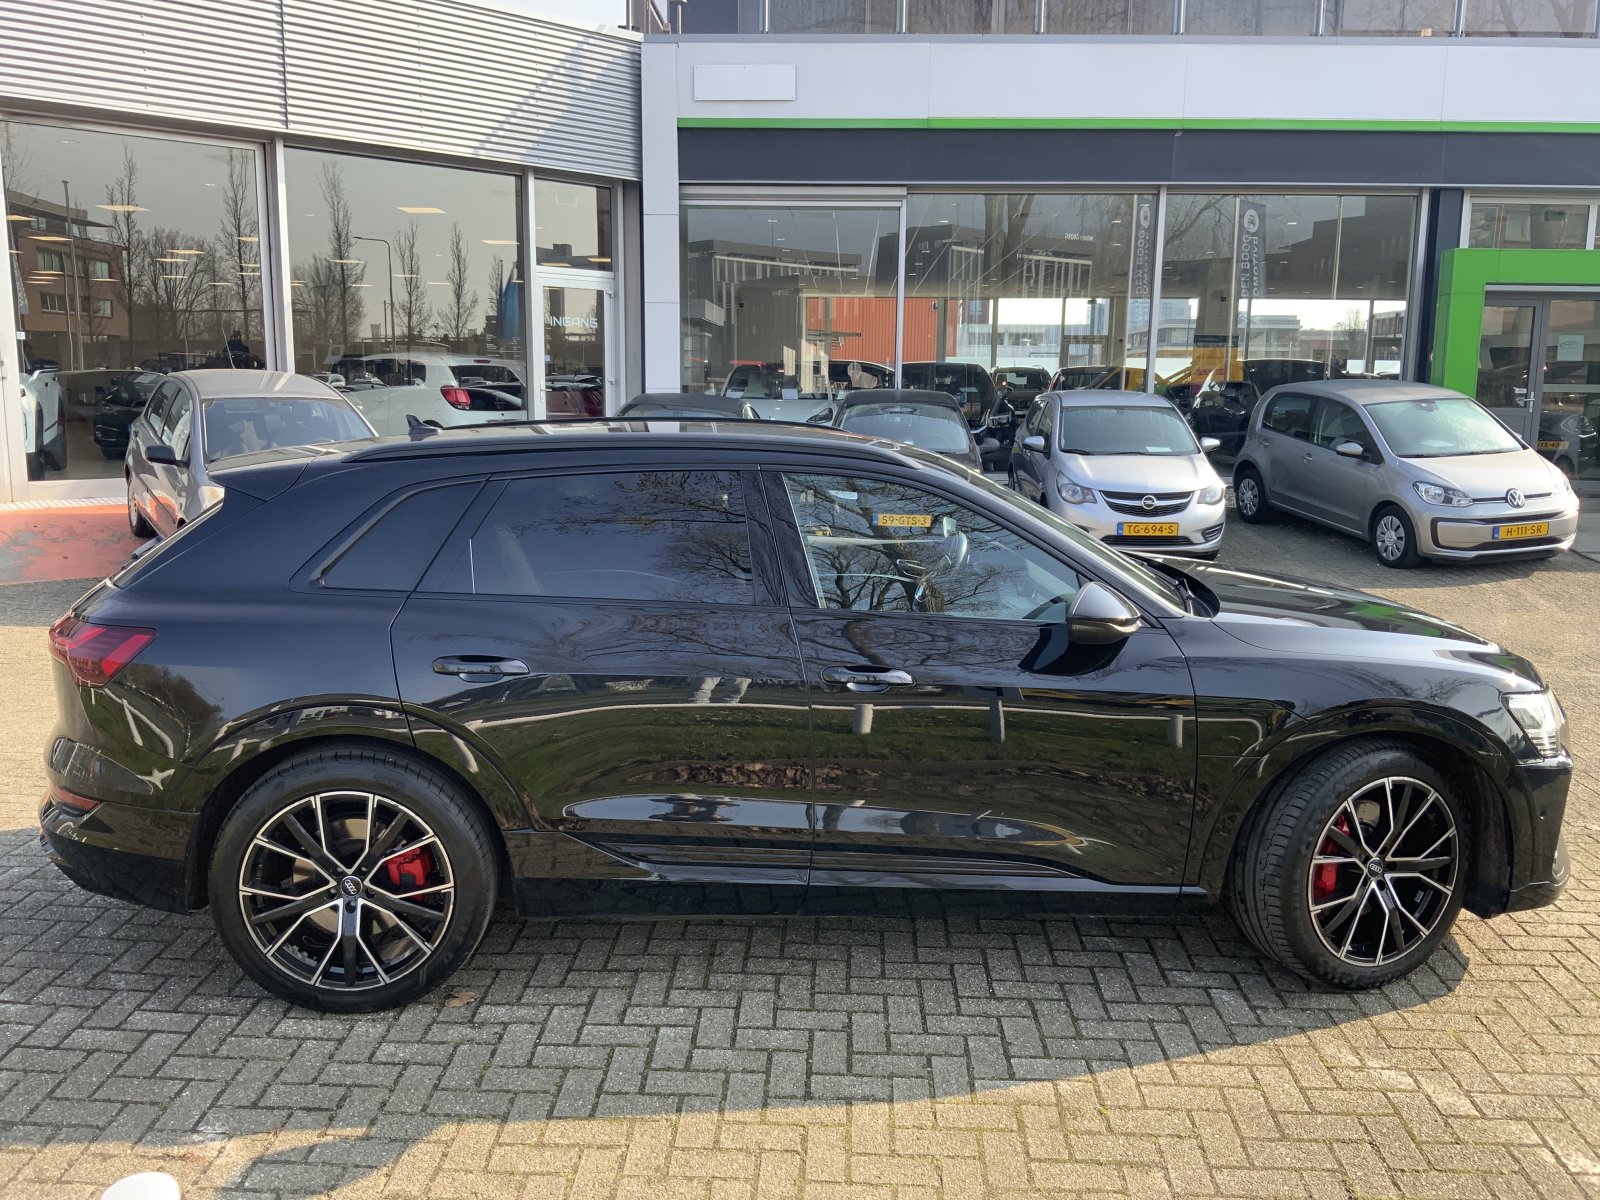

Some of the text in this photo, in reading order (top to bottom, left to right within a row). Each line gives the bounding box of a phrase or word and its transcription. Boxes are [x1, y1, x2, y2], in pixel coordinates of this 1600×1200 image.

[1240, 234, 1251, 269] BOOG
[1240, 273, 1250, 298] DEN
[550, 315, 598, 328] INGANG
[881, 515, 927, 526] 59-GTS-3
[1126, 524, 1174, 534] TG-694-S
[1506, 524, 1542, 537] H-111-SR
